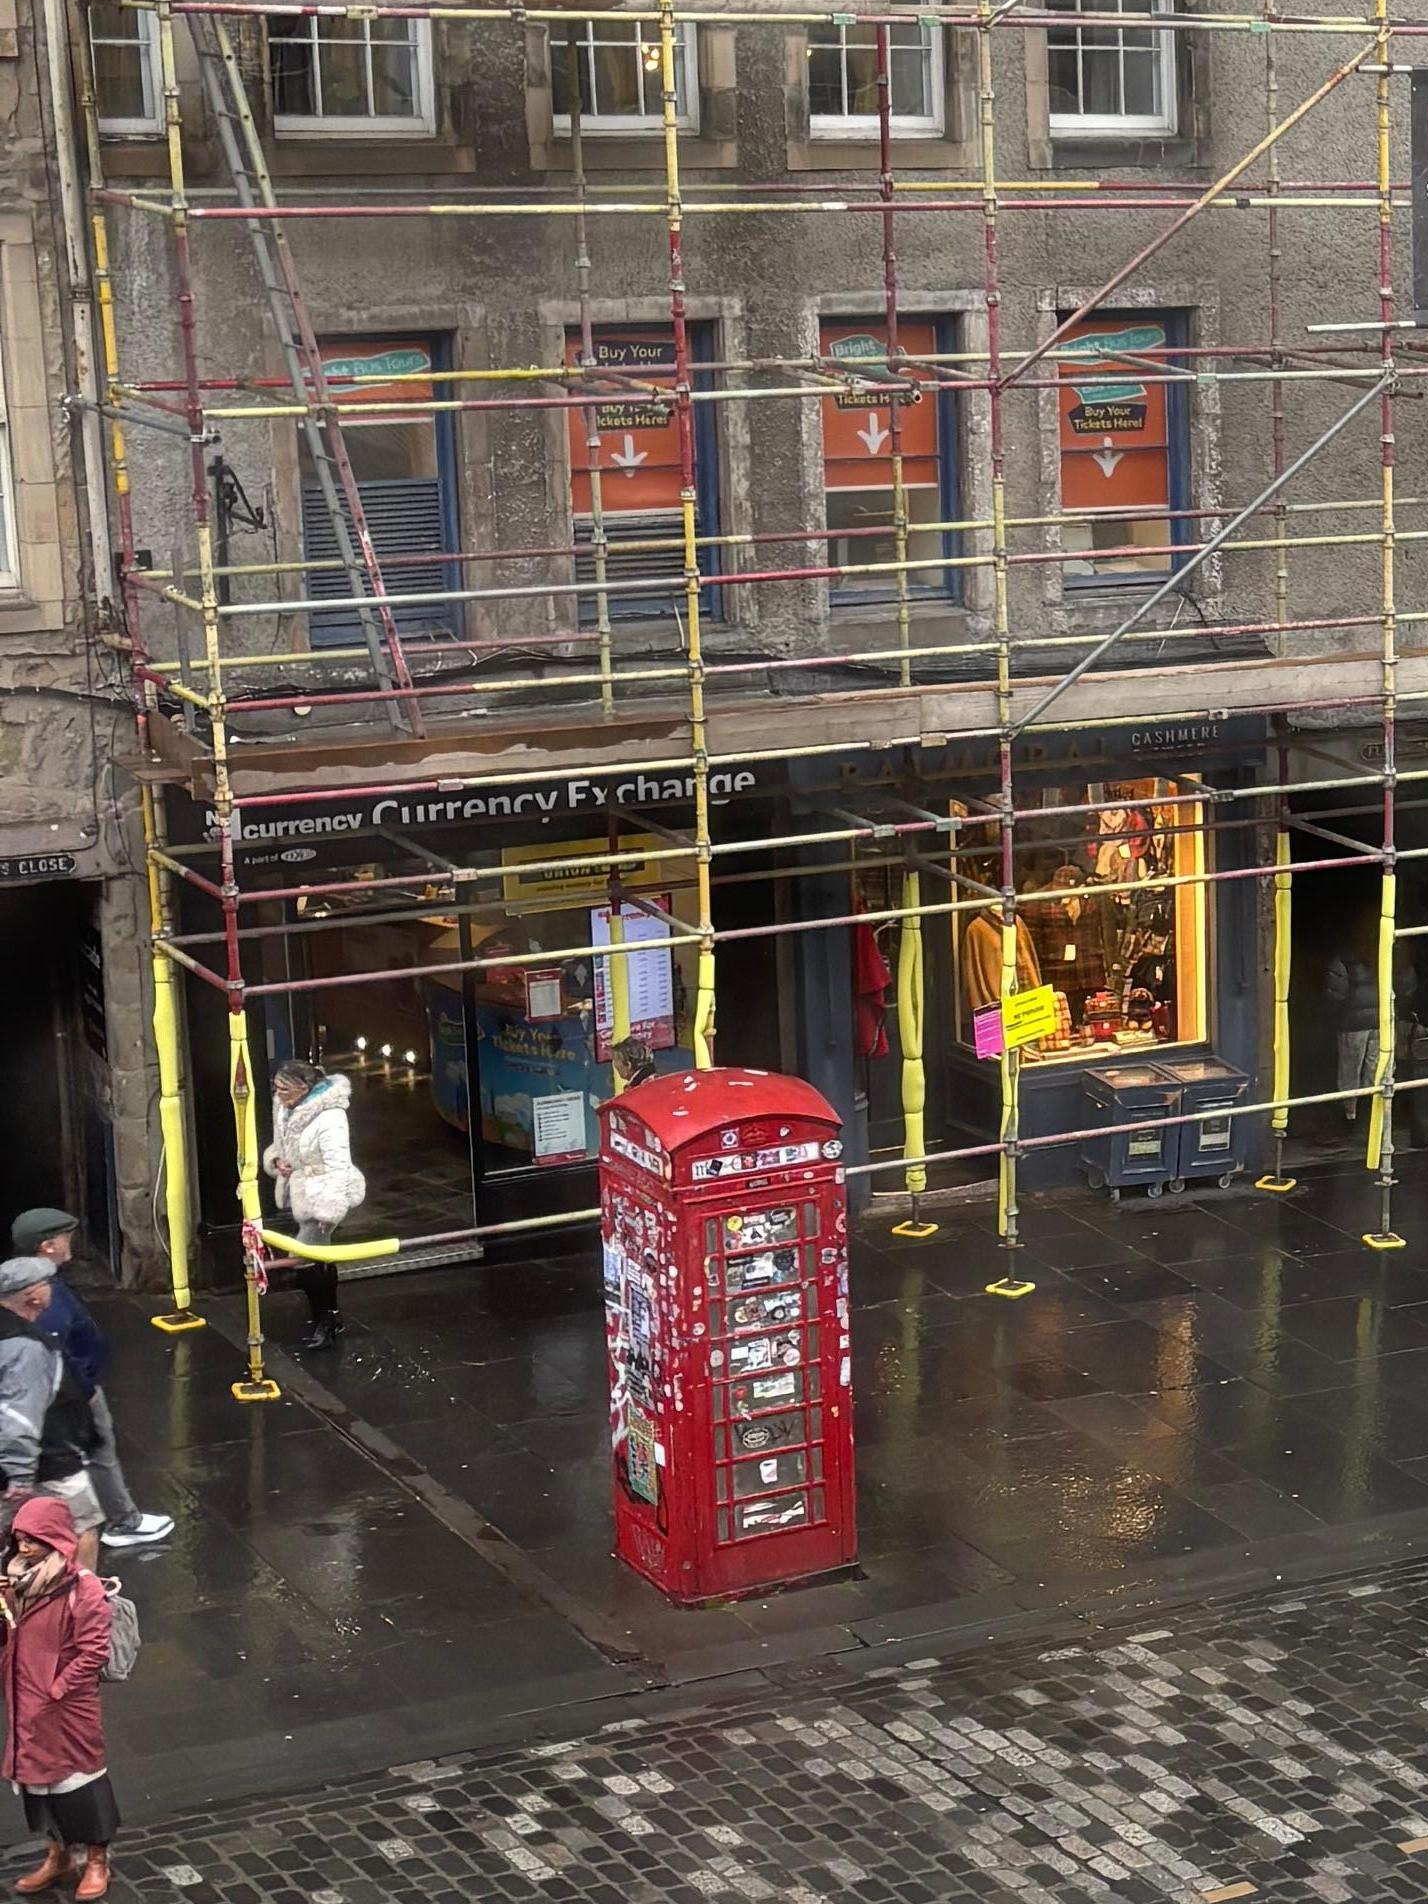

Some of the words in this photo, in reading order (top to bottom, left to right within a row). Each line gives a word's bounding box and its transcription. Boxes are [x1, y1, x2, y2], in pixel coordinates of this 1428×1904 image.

[599, 345, 626, 360] Buy
[630, 345, 662, 357] Your
[1084, 406, 1105, 418] Buy
[1107, 405, 1132, 416] Your
[1075, 419, 1112, 430] Tickets
[1132, 725, 1219, 745] CASHMERE
[243, 812, 362, 841] currency
[19, 857, 68, 874] CLOSE
